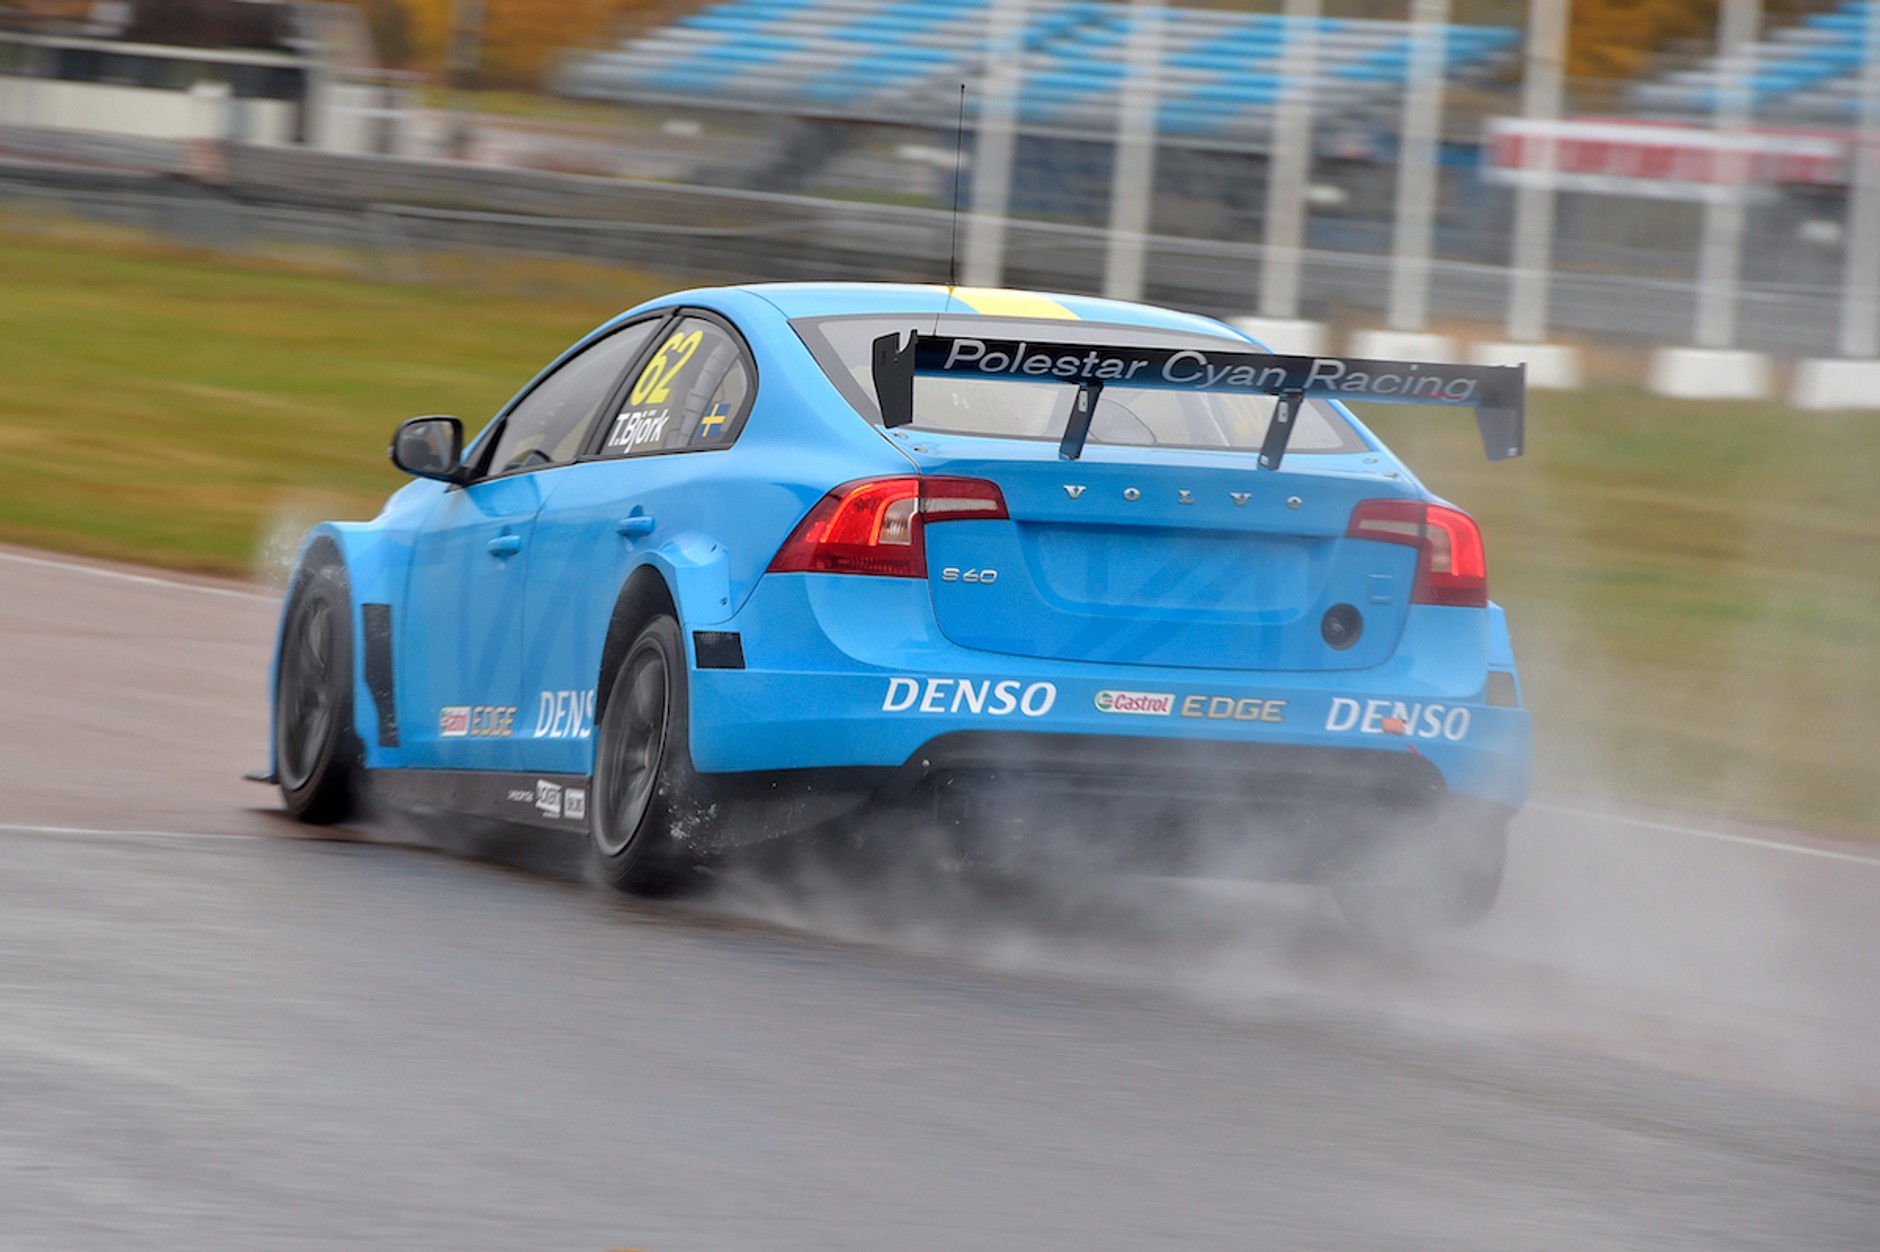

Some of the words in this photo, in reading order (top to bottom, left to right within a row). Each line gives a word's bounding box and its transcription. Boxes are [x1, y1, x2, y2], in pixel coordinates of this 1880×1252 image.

[630, 330, 704, 406] 62
[943, 338, 1148, 380] Polestar
[1161, 350, 1289, 391] Cyan
[1302, 359, 1478, 400] Racing
[608, 409, 669, 454] T.Björk
[1063, 484, 1303, 510] VOLVO
[941, 567, 998, 584] S60
[882, 677, 1057, 717] DENSO
[1113, 693, 1169, 713] Castrol
[1181, 695, 1287, 722] EDGE
[470, 706, 517, 738] EDGE
[1325, 697, 1470, 741] DENSO
